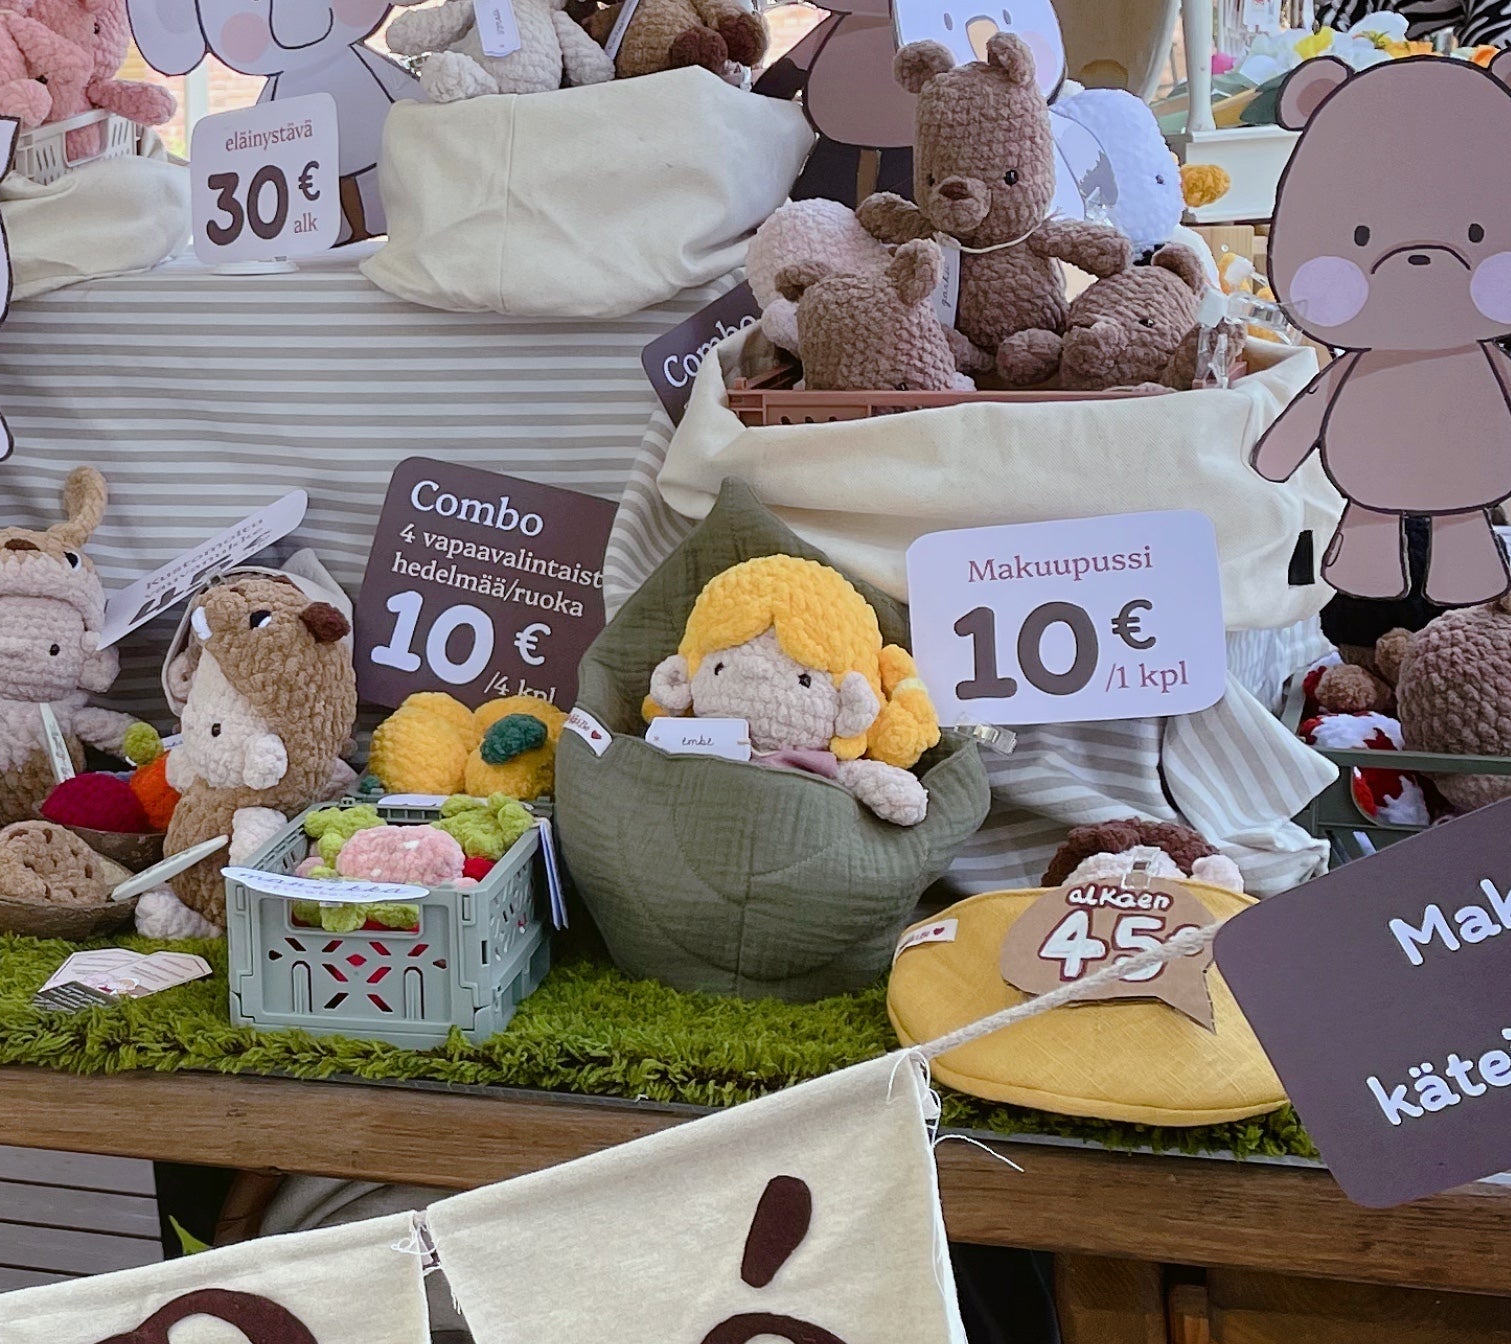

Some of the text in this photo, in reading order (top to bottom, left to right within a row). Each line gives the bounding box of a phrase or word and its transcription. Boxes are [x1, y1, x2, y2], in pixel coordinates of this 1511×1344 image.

[225, 119, 313, 152] eläinystävä
[206, 164, 289, 246] 30
[294, 212, 319, 234] alk
[411, 480, 544, 537] Combo
[392, 551, 584, 617] hedelmää/ruoka
[400, 523, 604, 589] 4 vapaavalintaist
[968, 545, 1153, 583] Makuupussi
[371, 590, 552, 685] 10 €
[954, 601, 1099, 700] 10
[1139, 660, 1189, 693] kpl
[1366, 1027, 1511, 1125] käte
